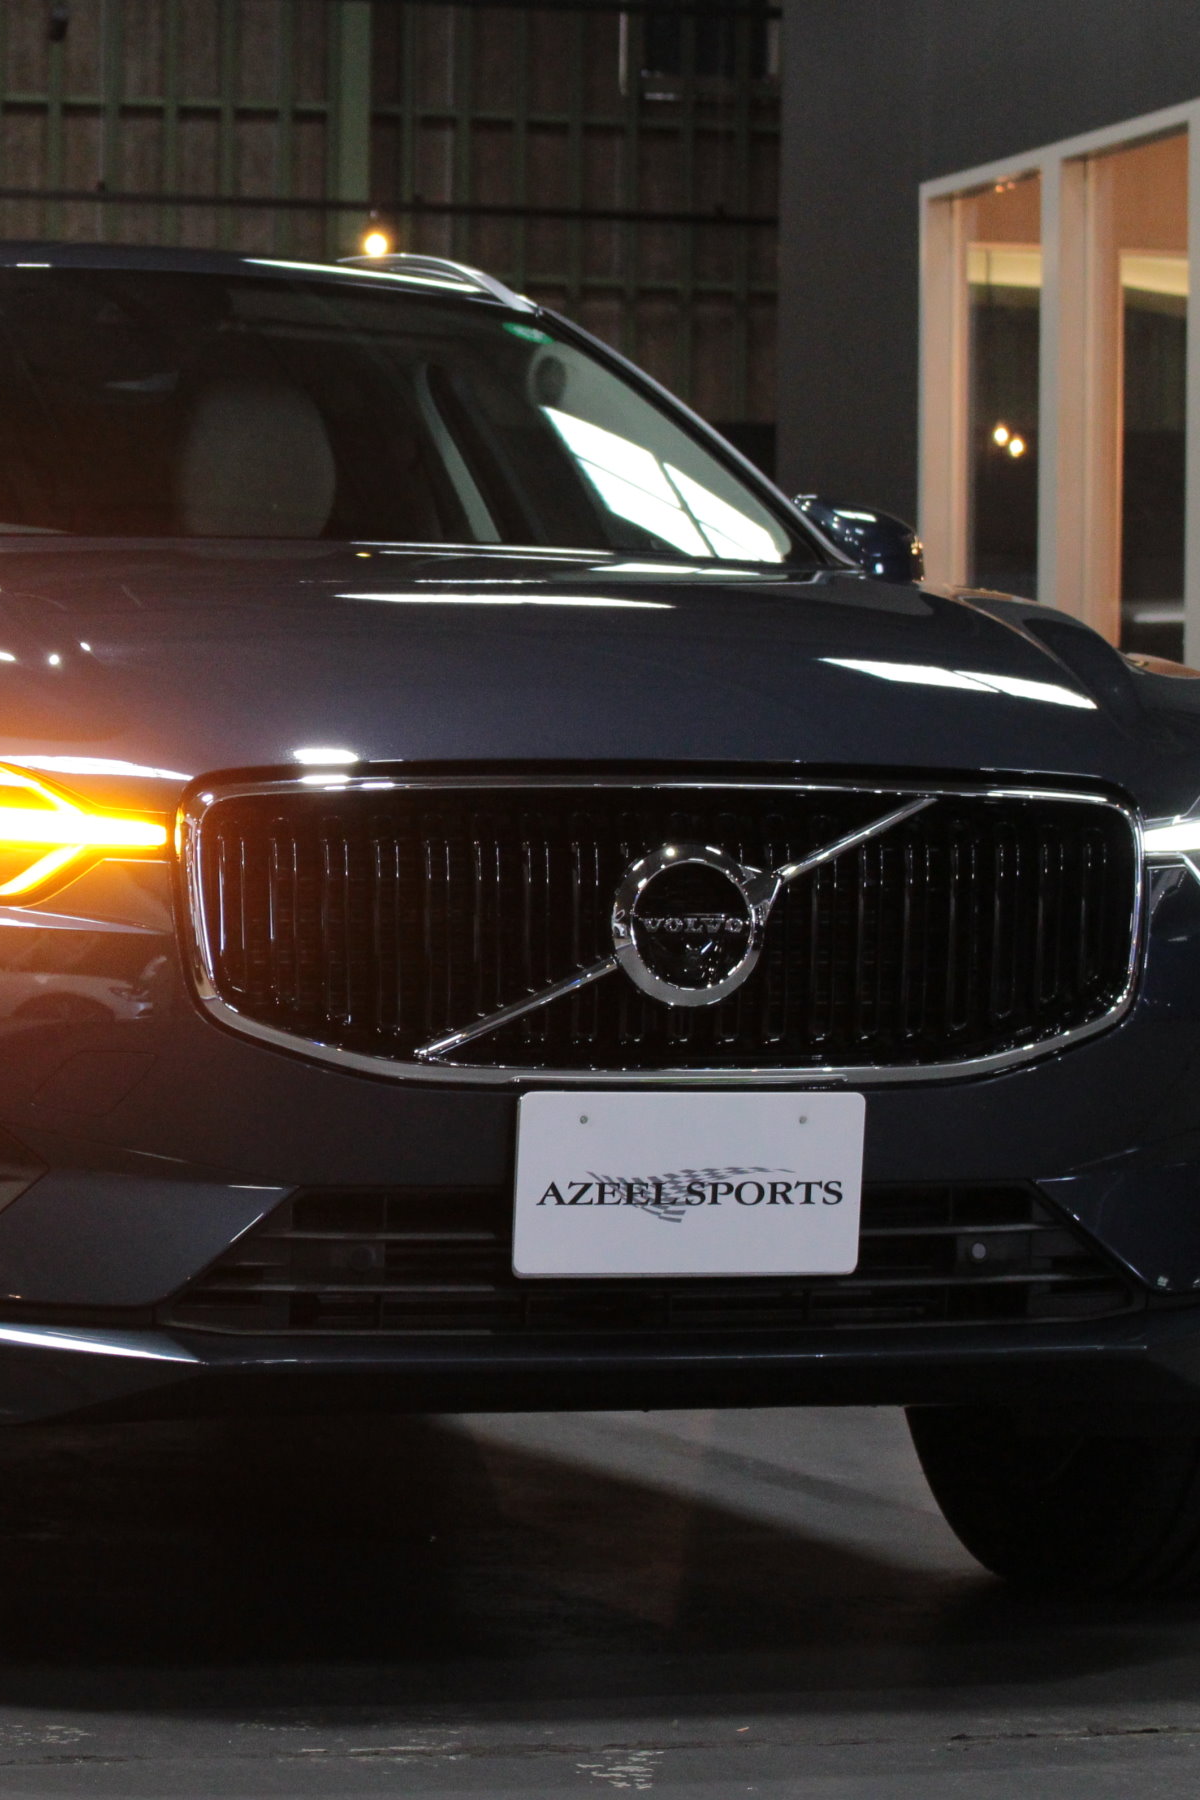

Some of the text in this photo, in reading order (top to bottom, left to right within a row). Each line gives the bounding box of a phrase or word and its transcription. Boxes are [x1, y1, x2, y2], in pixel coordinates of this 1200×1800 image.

[639, 917, 744, 934] VOLVO
[536, 1180, 844, 1206] AZEEL SPORTS
